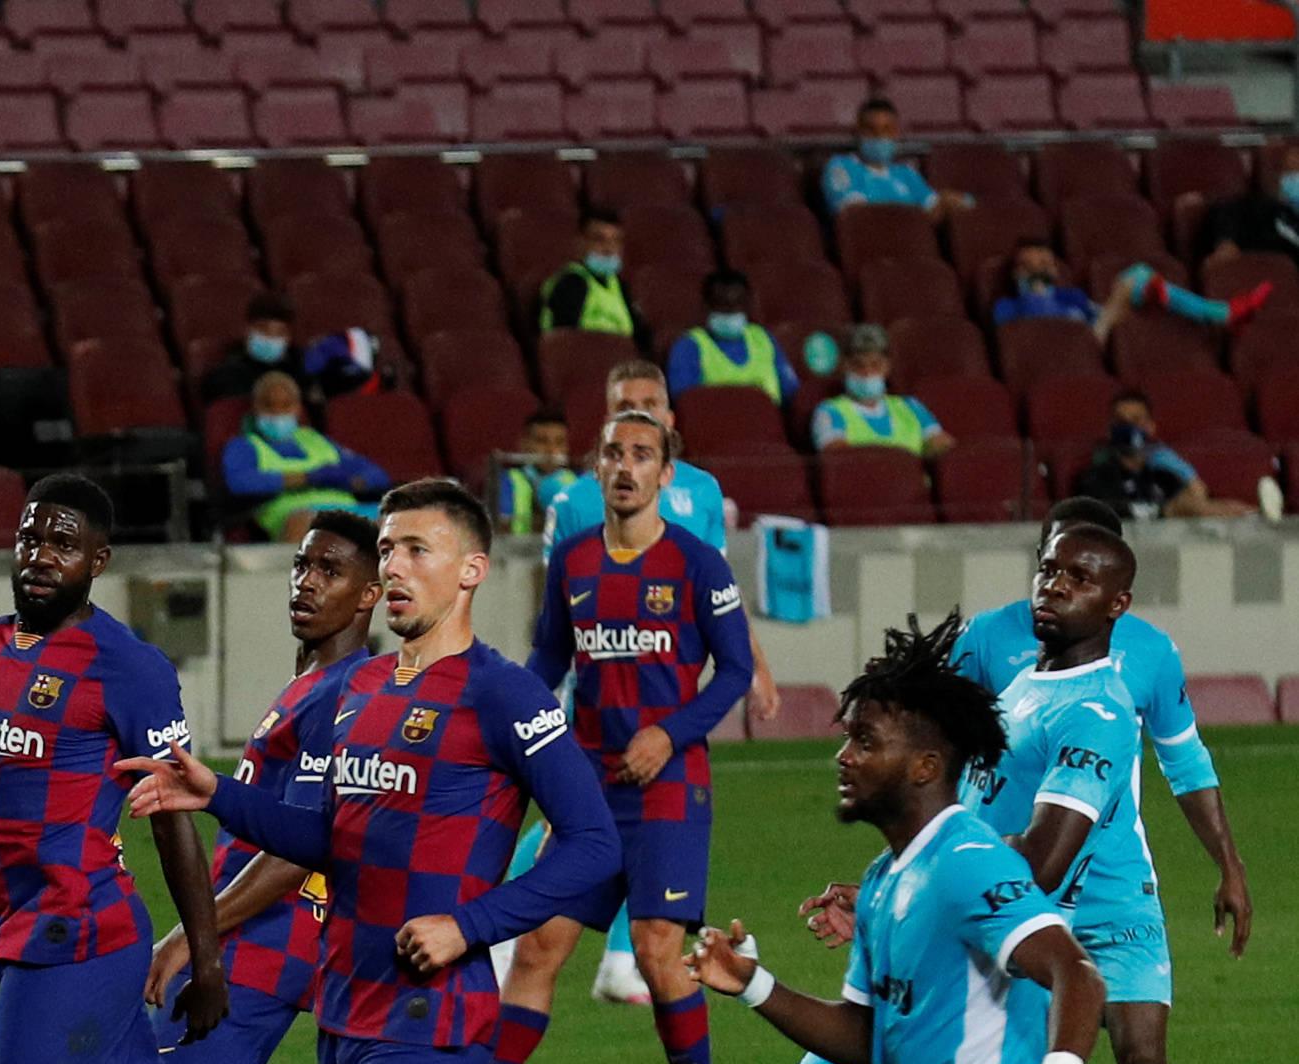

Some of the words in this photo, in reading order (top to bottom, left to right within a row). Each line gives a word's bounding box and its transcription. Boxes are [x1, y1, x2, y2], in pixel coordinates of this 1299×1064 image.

[711, 584, 739, 605] bek
[574, 623, 671, 653] Rakuten
[513, 708, 566, 740] beko
[332, 748, 418, 794] kuten
[1057, 746, 1113, 781] KFC
[1111, 923, 1162, 945] DION
